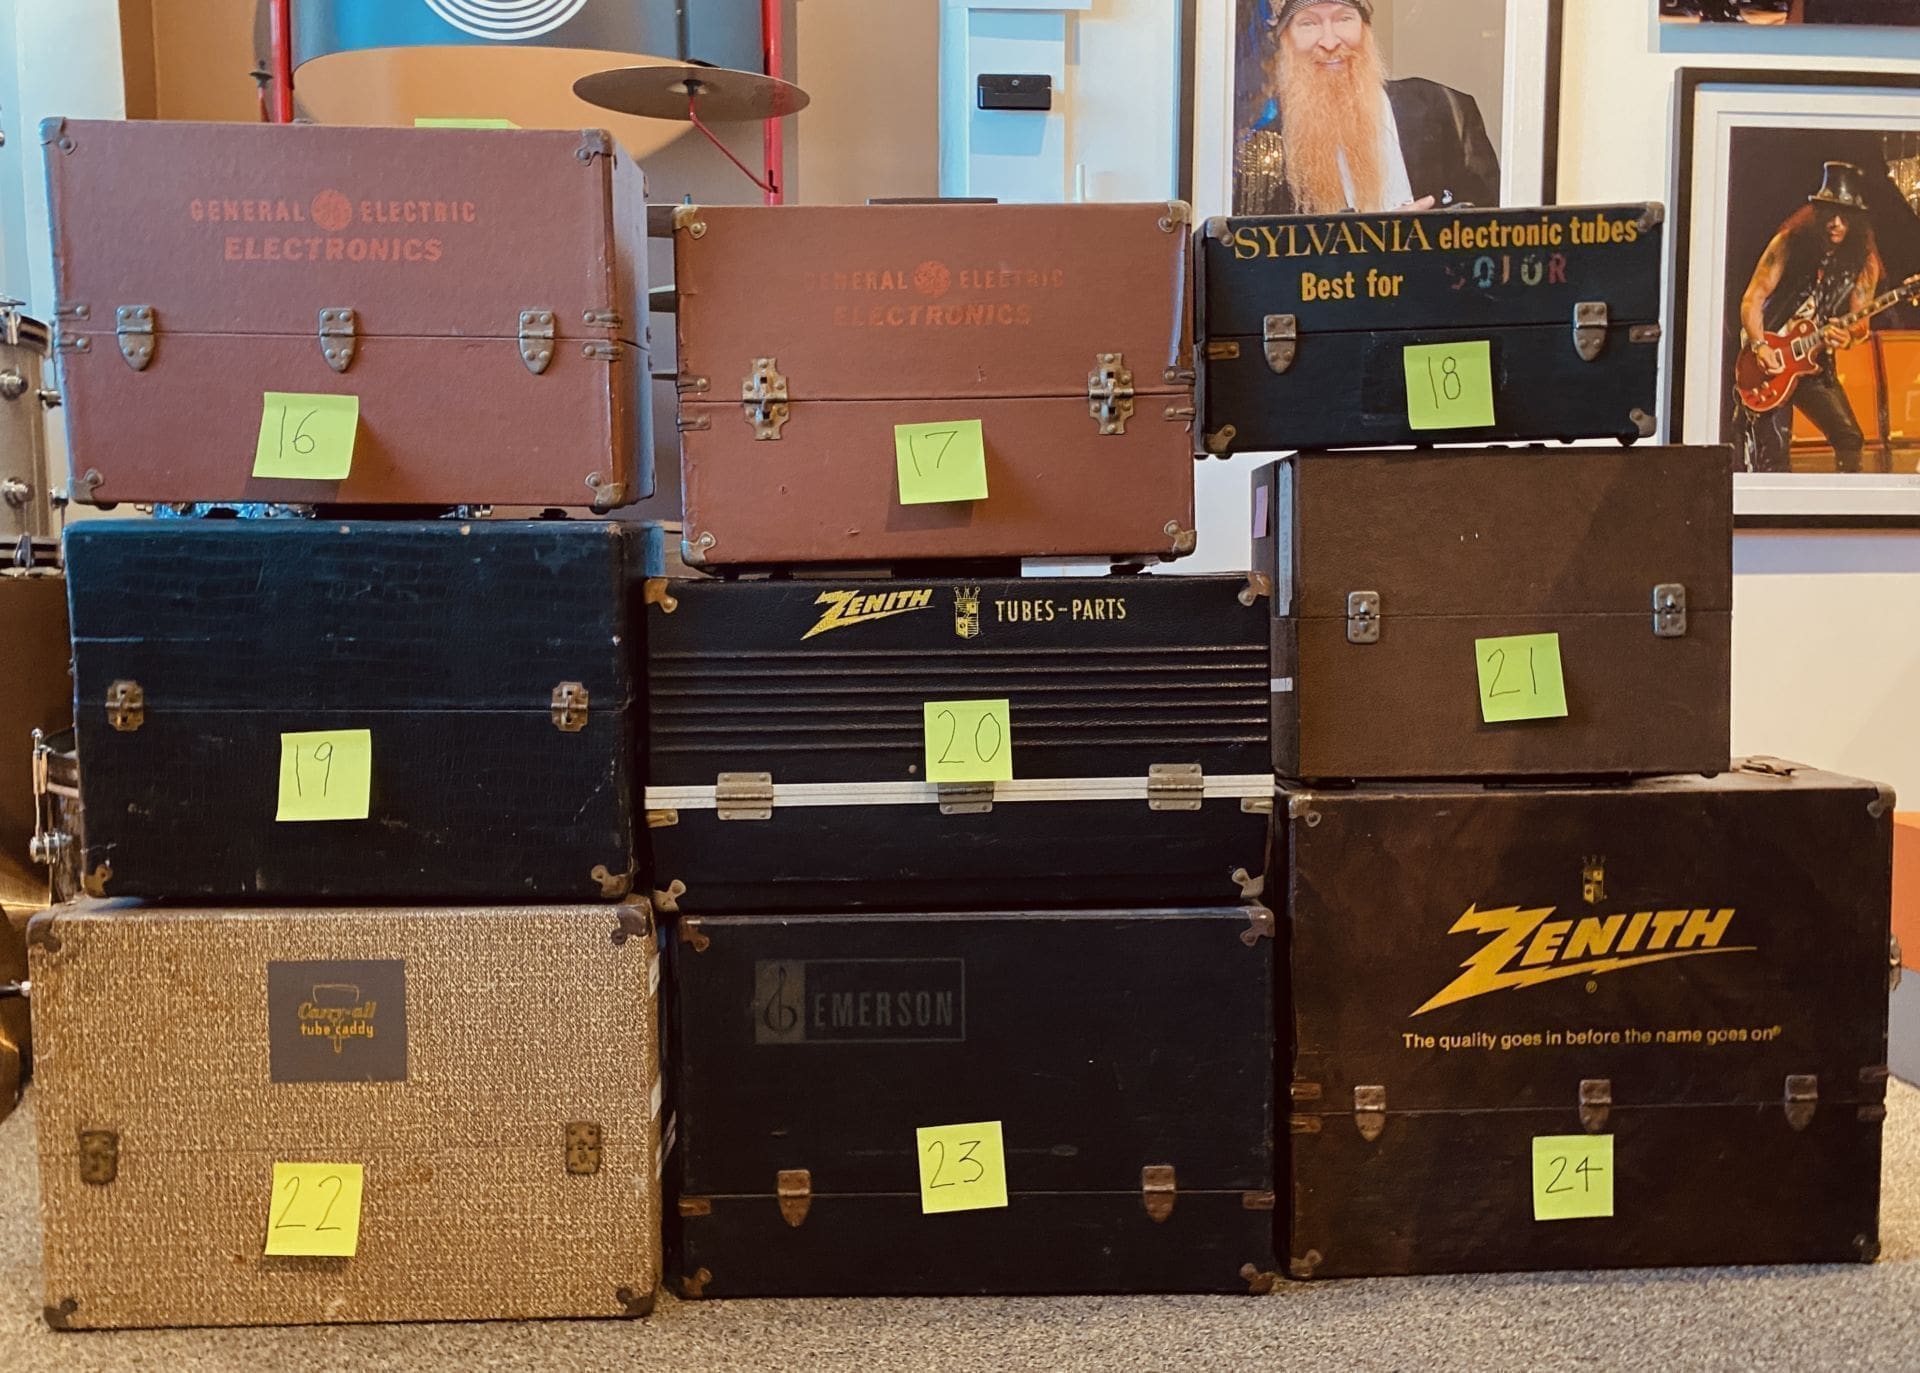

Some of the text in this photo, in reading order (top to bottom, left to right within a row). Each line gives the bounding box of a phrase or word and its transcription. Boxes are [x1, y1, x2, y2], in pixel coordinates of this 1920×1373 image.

[191, 199, 305, 222] GENERAL
[361, 201, 476, 223] ELECTRIC
[225, 237, 443, 261] ELECTRONICS
[1234, 213, 1638, 259] SYLVANIA electronic tubes
[1301, 271, 1355, 301] Best
[1366, 268, 1404, 297] for
[832, 303, 1032, 326] ELECTRONICS
[1427, 355, 1462, 409] 18
[279, 405, 317, 459] 16
[909, 430, 959, 477] 17
[800, 588, 935, 641] ZENITH
[1487, 646, 1537, 699] 21
[937, 709, 1002, 765] 20
[295, 741, 334, 798] 19
[1408, 902, 1757, 1018] ZENITH
[301, 1020, 374, 1038] tube caddy
[813, 991, 953, 1027] EMERSON
[1402, 1033, 1436, 1049] The
[1439, 1032, 1496, 1051] quality
[1500, 1033, 1542, 1050] goes
[1546, 1030, 1561, 1045] in
[1566, 1028, 1621, 1045] before
[1624, 1028, 1652, 1044] the
[1655, 1029, 1702, 1042] name
[1706, 1028, 1748, 1045] goes
[927, 1140, 985, 1190] 23
[1544, 1155, 1604, 1194] 24
[273, 1174, 345, 1232] 22
